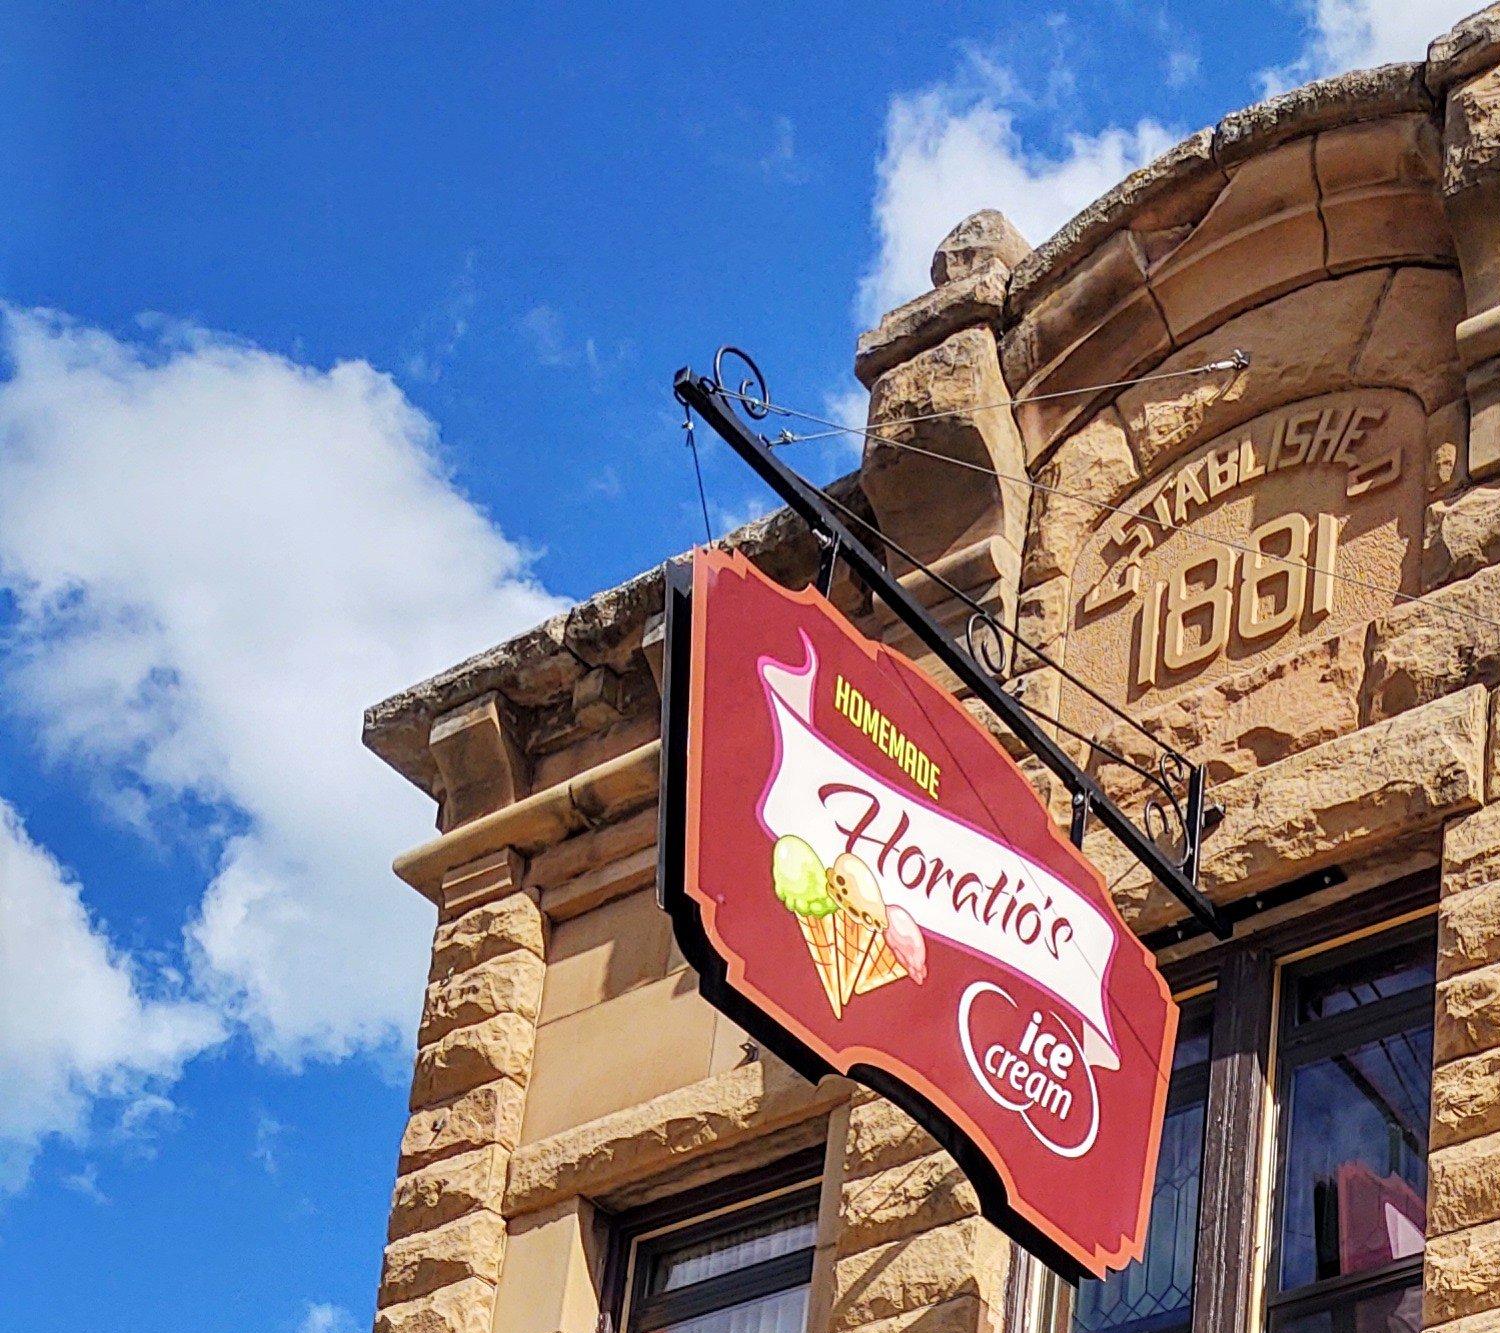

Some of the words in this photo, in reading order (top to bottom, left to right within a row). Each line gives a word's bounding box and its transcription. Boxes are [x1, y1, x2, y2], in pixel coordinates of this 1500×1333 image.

[1083, 407, 1401, 612] ESTABLISHED
[1137, 512, 1338, 685] 1881
[834, 674, 942, 802] HOMEMADE
[817, 782, 1075, 961] Horatio's
[985, 1044, 1073, 1121] cream
[1019, 1011, 1075, 1081] ice
